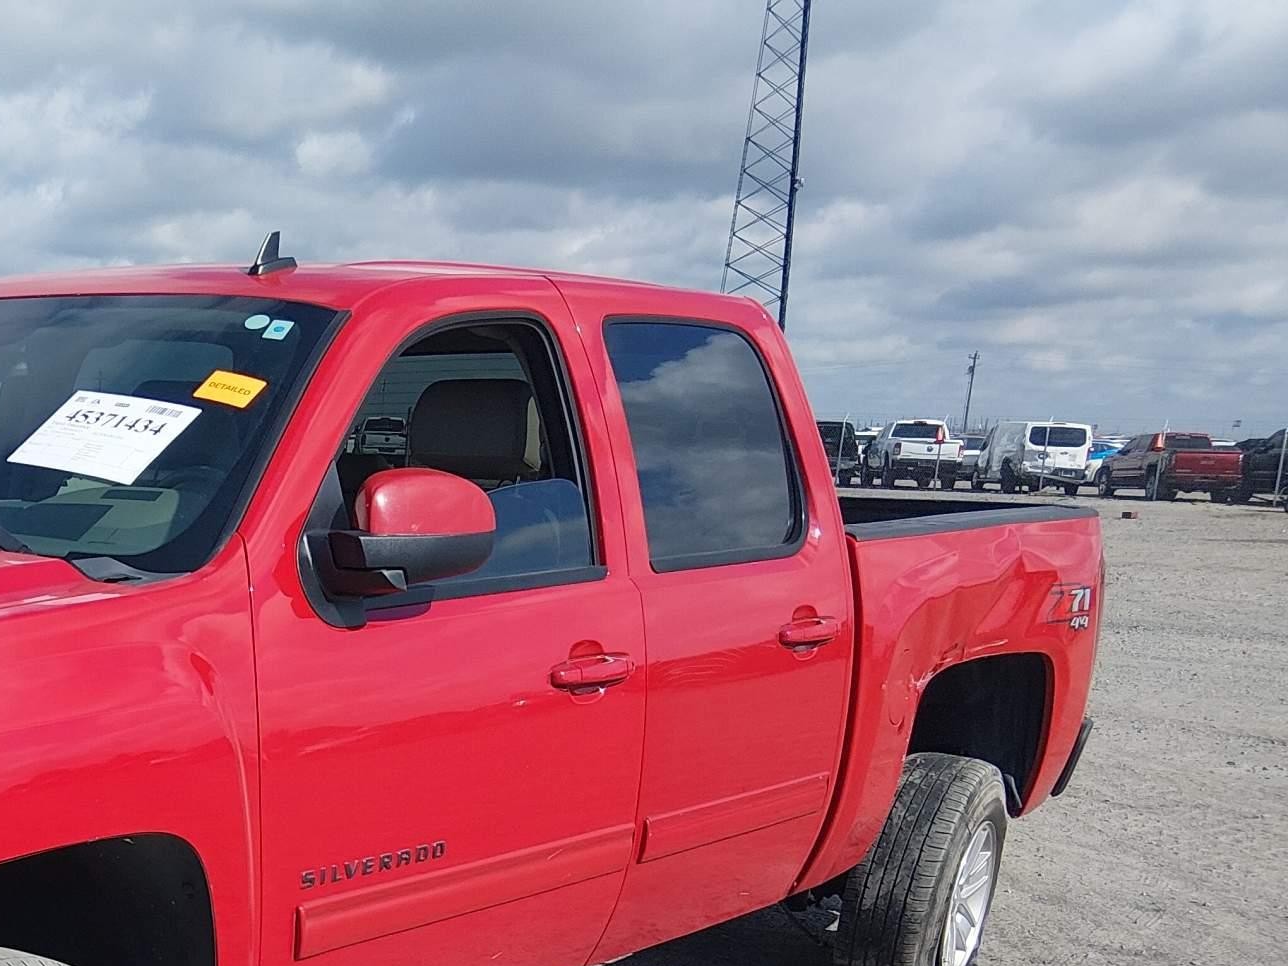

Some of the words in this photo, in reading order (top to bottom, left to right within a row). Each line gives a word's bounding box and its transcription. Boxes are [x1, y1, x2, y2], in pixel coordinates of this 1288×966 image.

[208, 381, 251, 396] DETAILED
[66, 409, 168, 436] 45371434
[299, 840, 447, 890] SILVERADO
